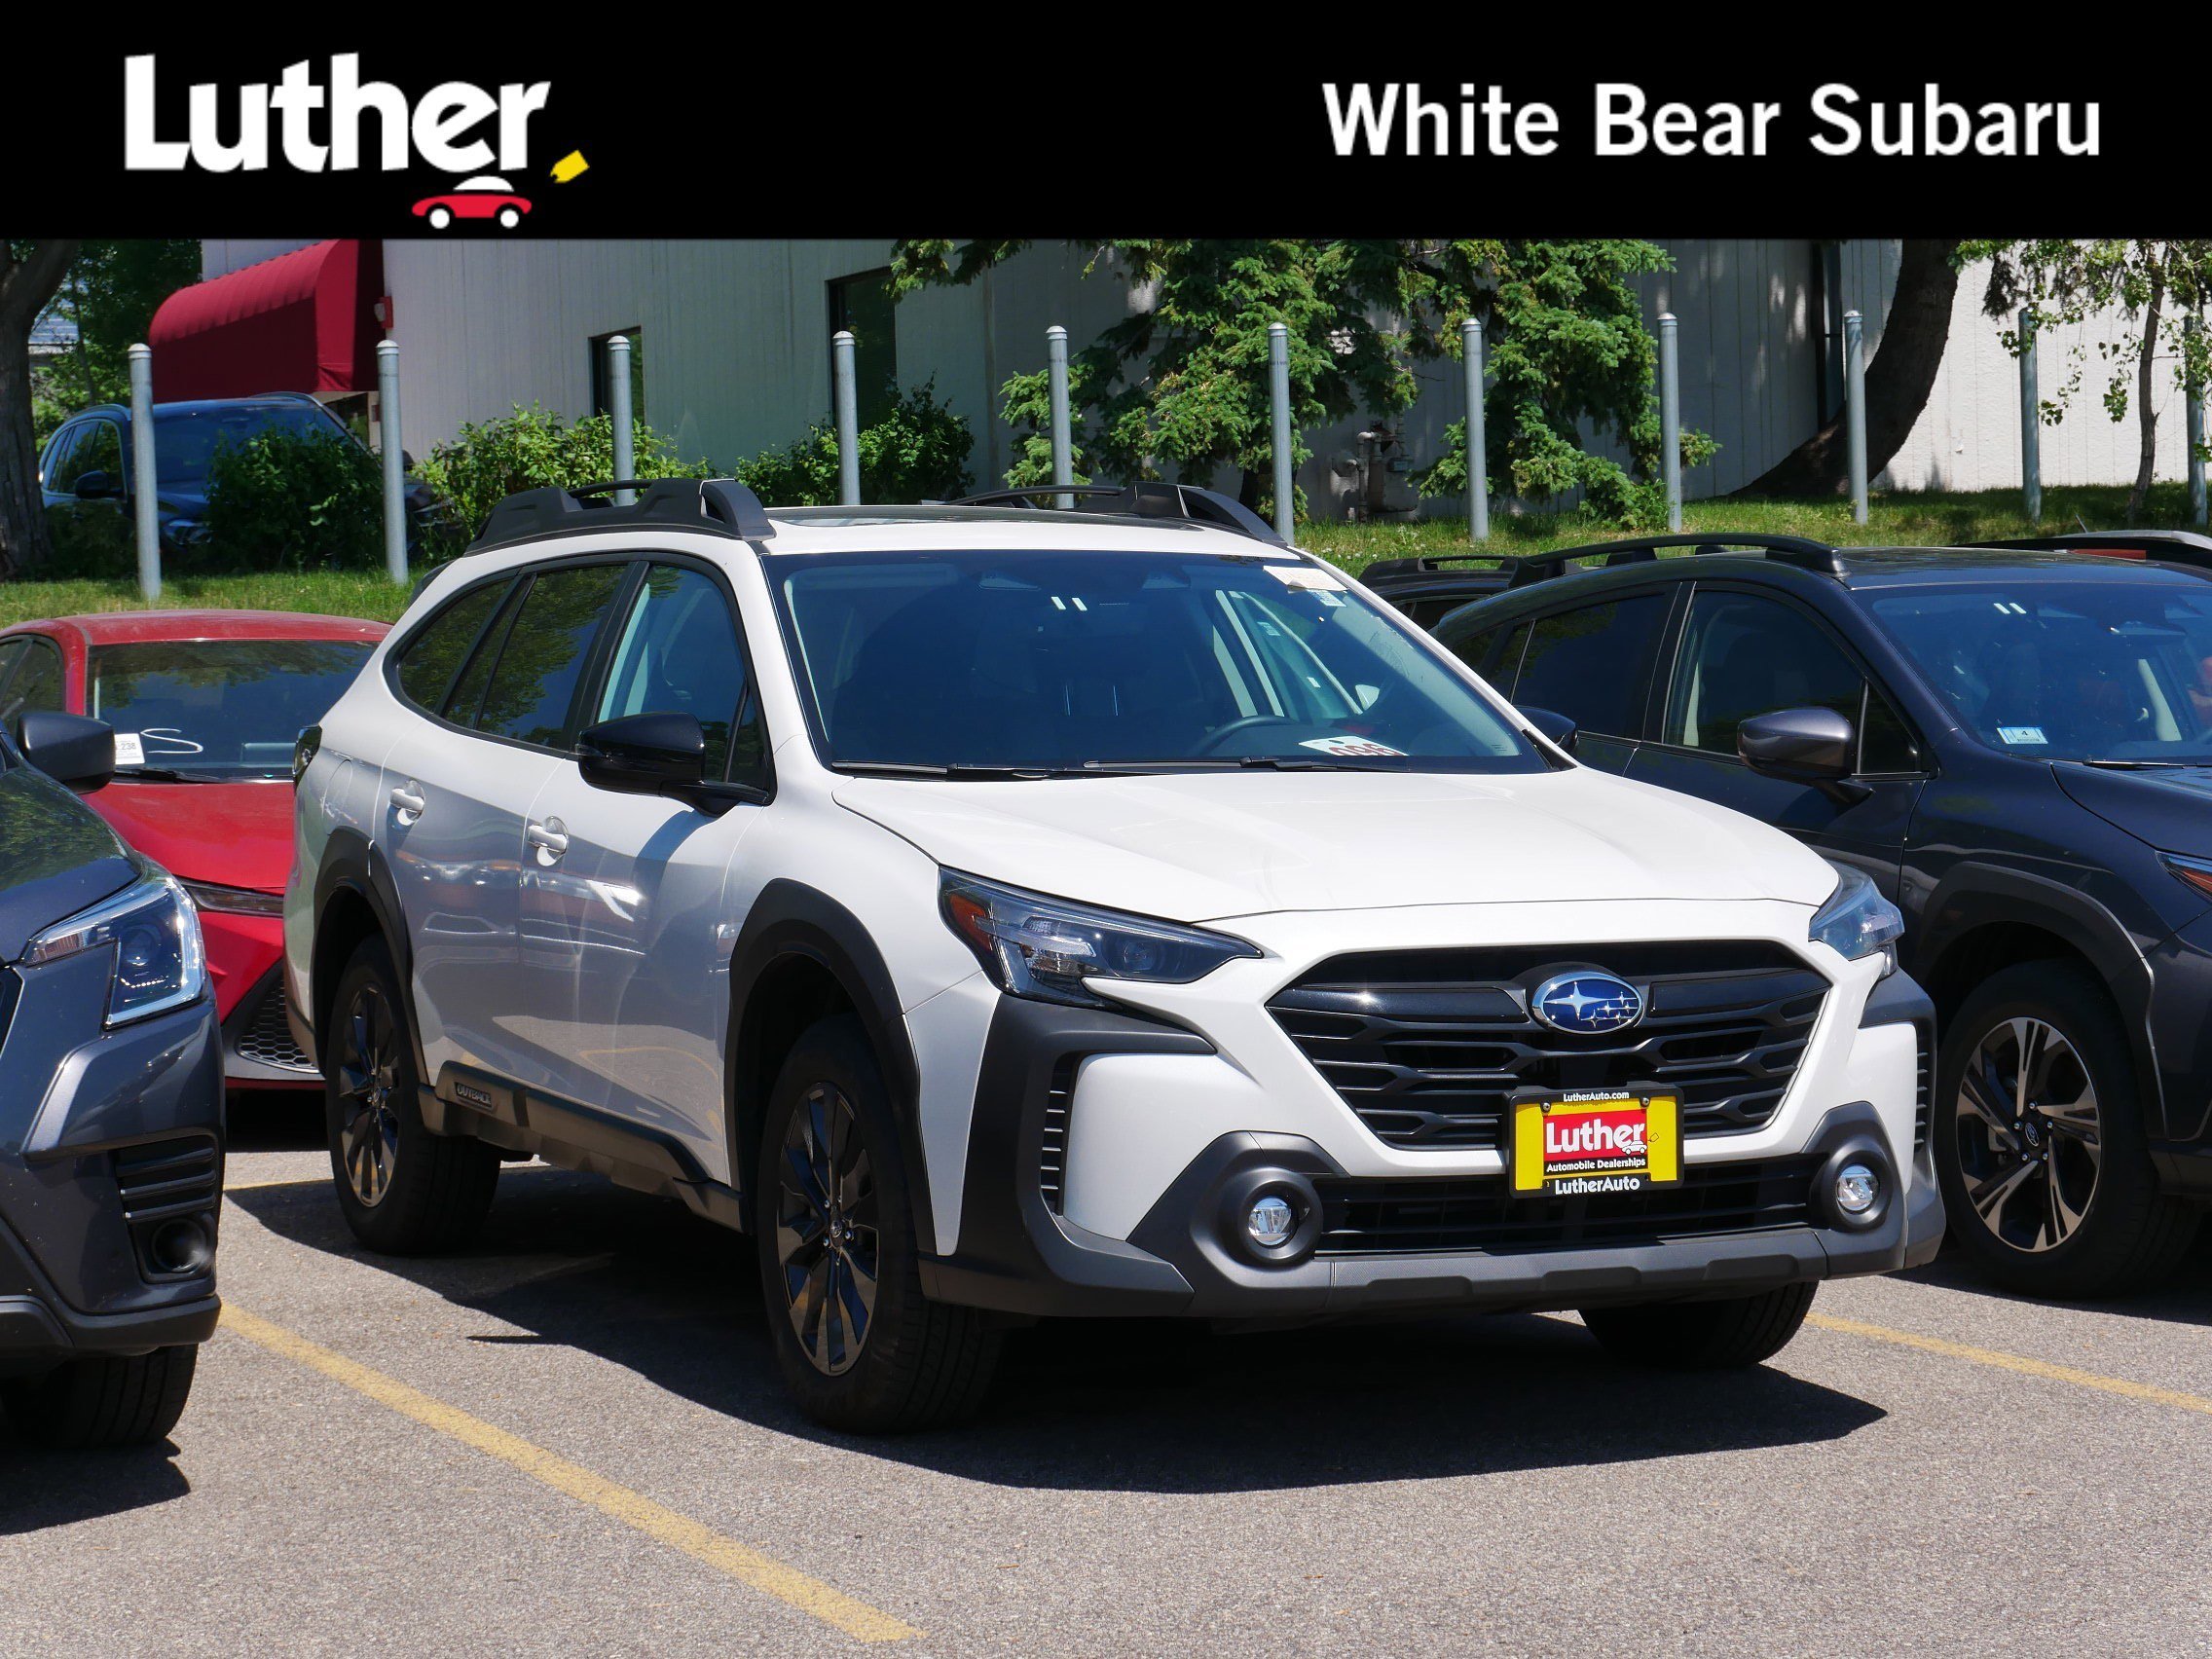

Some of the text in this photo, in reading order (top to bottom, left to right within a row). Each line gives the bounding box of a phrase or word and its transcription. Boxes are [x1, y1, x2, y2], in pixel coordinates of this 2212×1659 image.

[457, 1084, 492, 1105] OUTBACK
[1563, 1091, 1630, 1102] LutherAuto.com
[1545, 1118, 1645, 1154] Luther
[1546, 1158, 1646, 1172] Automobile Dealerships
[1555, 1176, 1641, 1196] LutherAuto
